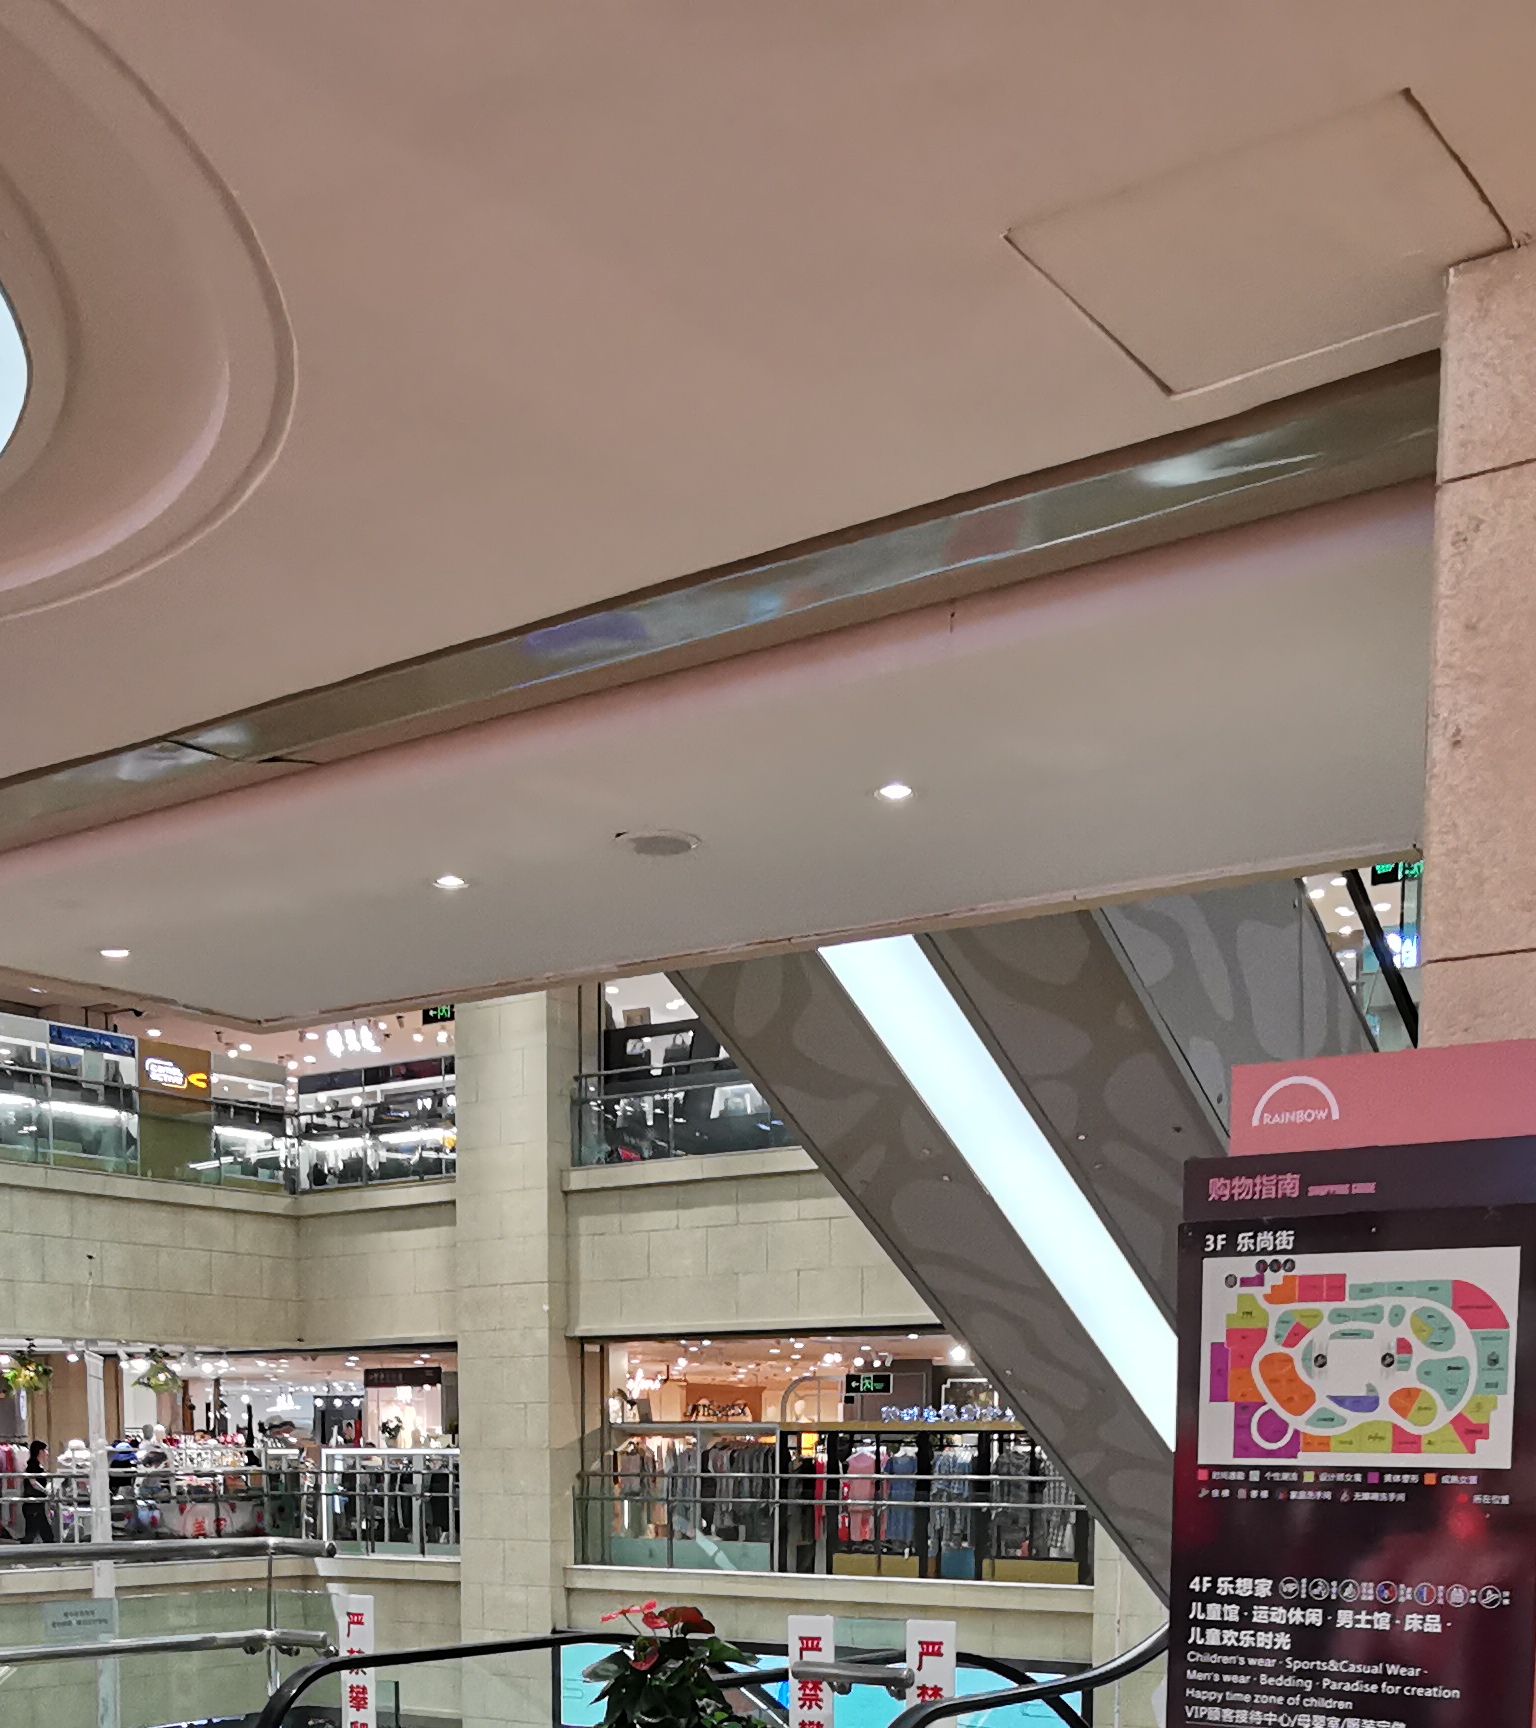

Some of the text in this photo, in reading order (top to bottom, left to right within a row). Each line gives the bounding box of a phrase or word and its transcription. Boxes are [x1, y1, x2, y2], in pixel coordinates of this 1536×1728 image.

[1262, 1107, 1329, 1126] RAINBOW
[1208, 1172, 1302, 1202] 购物指南
[1203, 1229, 1296, 1253] 3F 乐尚街
[1189, 1576, 1273, 1598] 4F 乐想家
[1189, 1602, 1443, 1634] 儿童馆 运动休闲 男士馆 床品
[1187, 1626, 1292, 1651] 儿童欢乐时光
[1186, 1651, 1422, 1677] Children's wear Sports&Casual Wear
[1186, 1669, 1462, 1700] Men's wear Bedding Paradise for creation
[1185, 1687, 1354, 1711] Happy time zone of children
